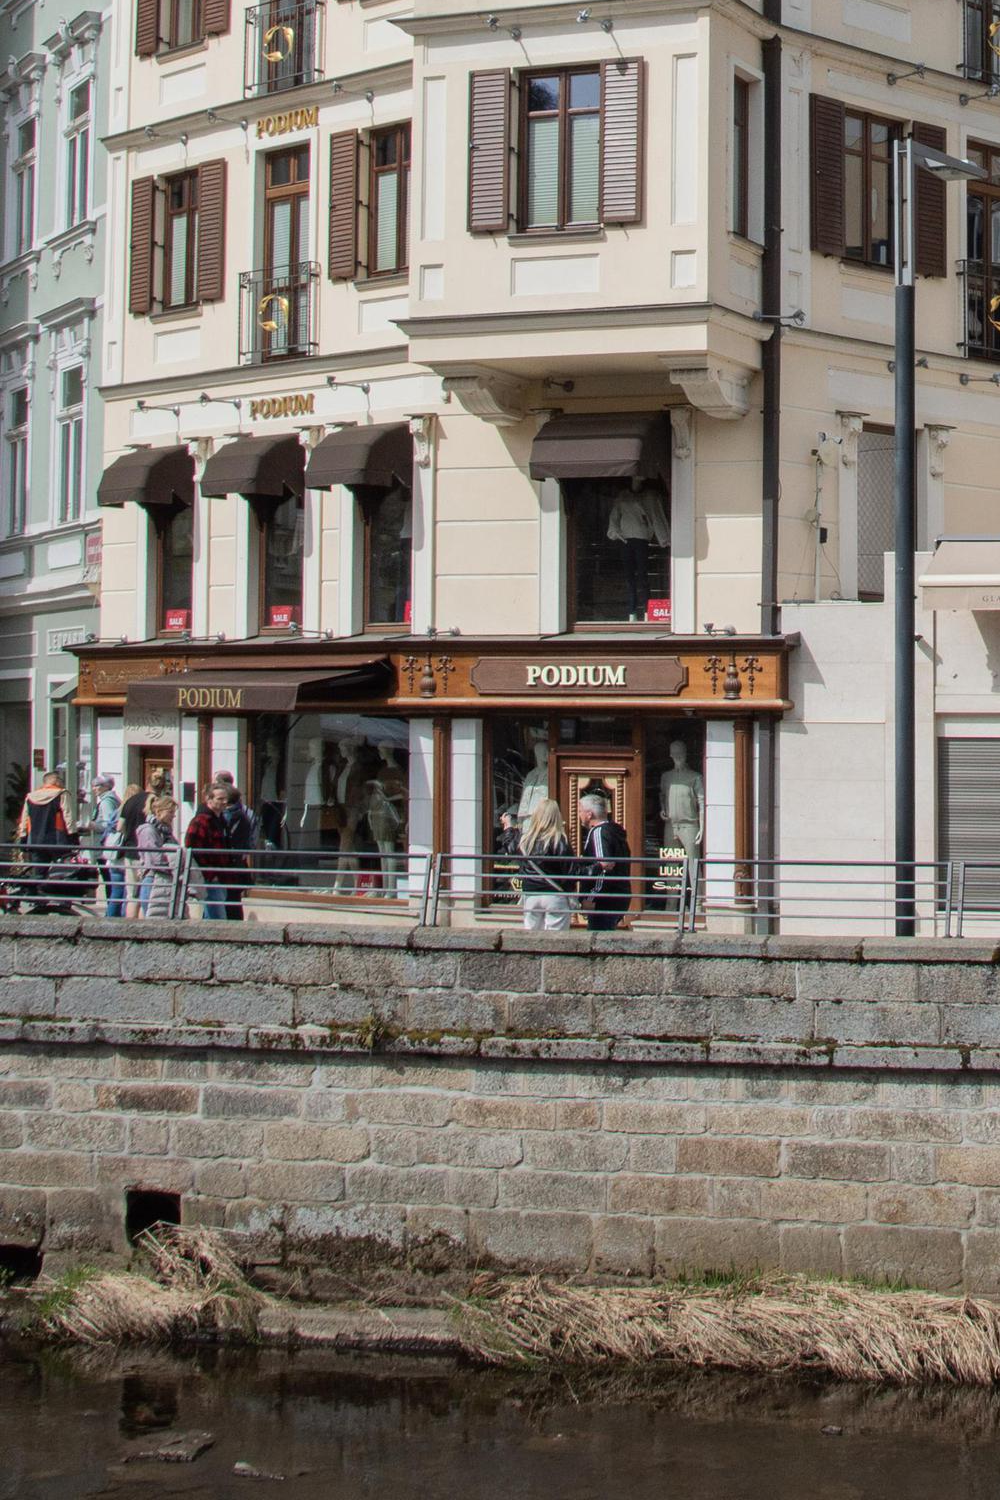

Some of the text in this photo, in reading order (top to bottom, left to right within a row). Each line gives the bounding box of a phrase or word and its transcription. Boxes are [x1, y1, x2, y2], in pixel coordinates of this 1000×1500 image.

[256, 105, 320, 139] PODIUM
[249, 393, 315, 420] PODIUM
[169, 617, 183, 626] SALE
[273, 613, 288, 622] SALE
[526, 665, 627, 687] PODIUM
[178, 687, 242, 708] PODIUM
